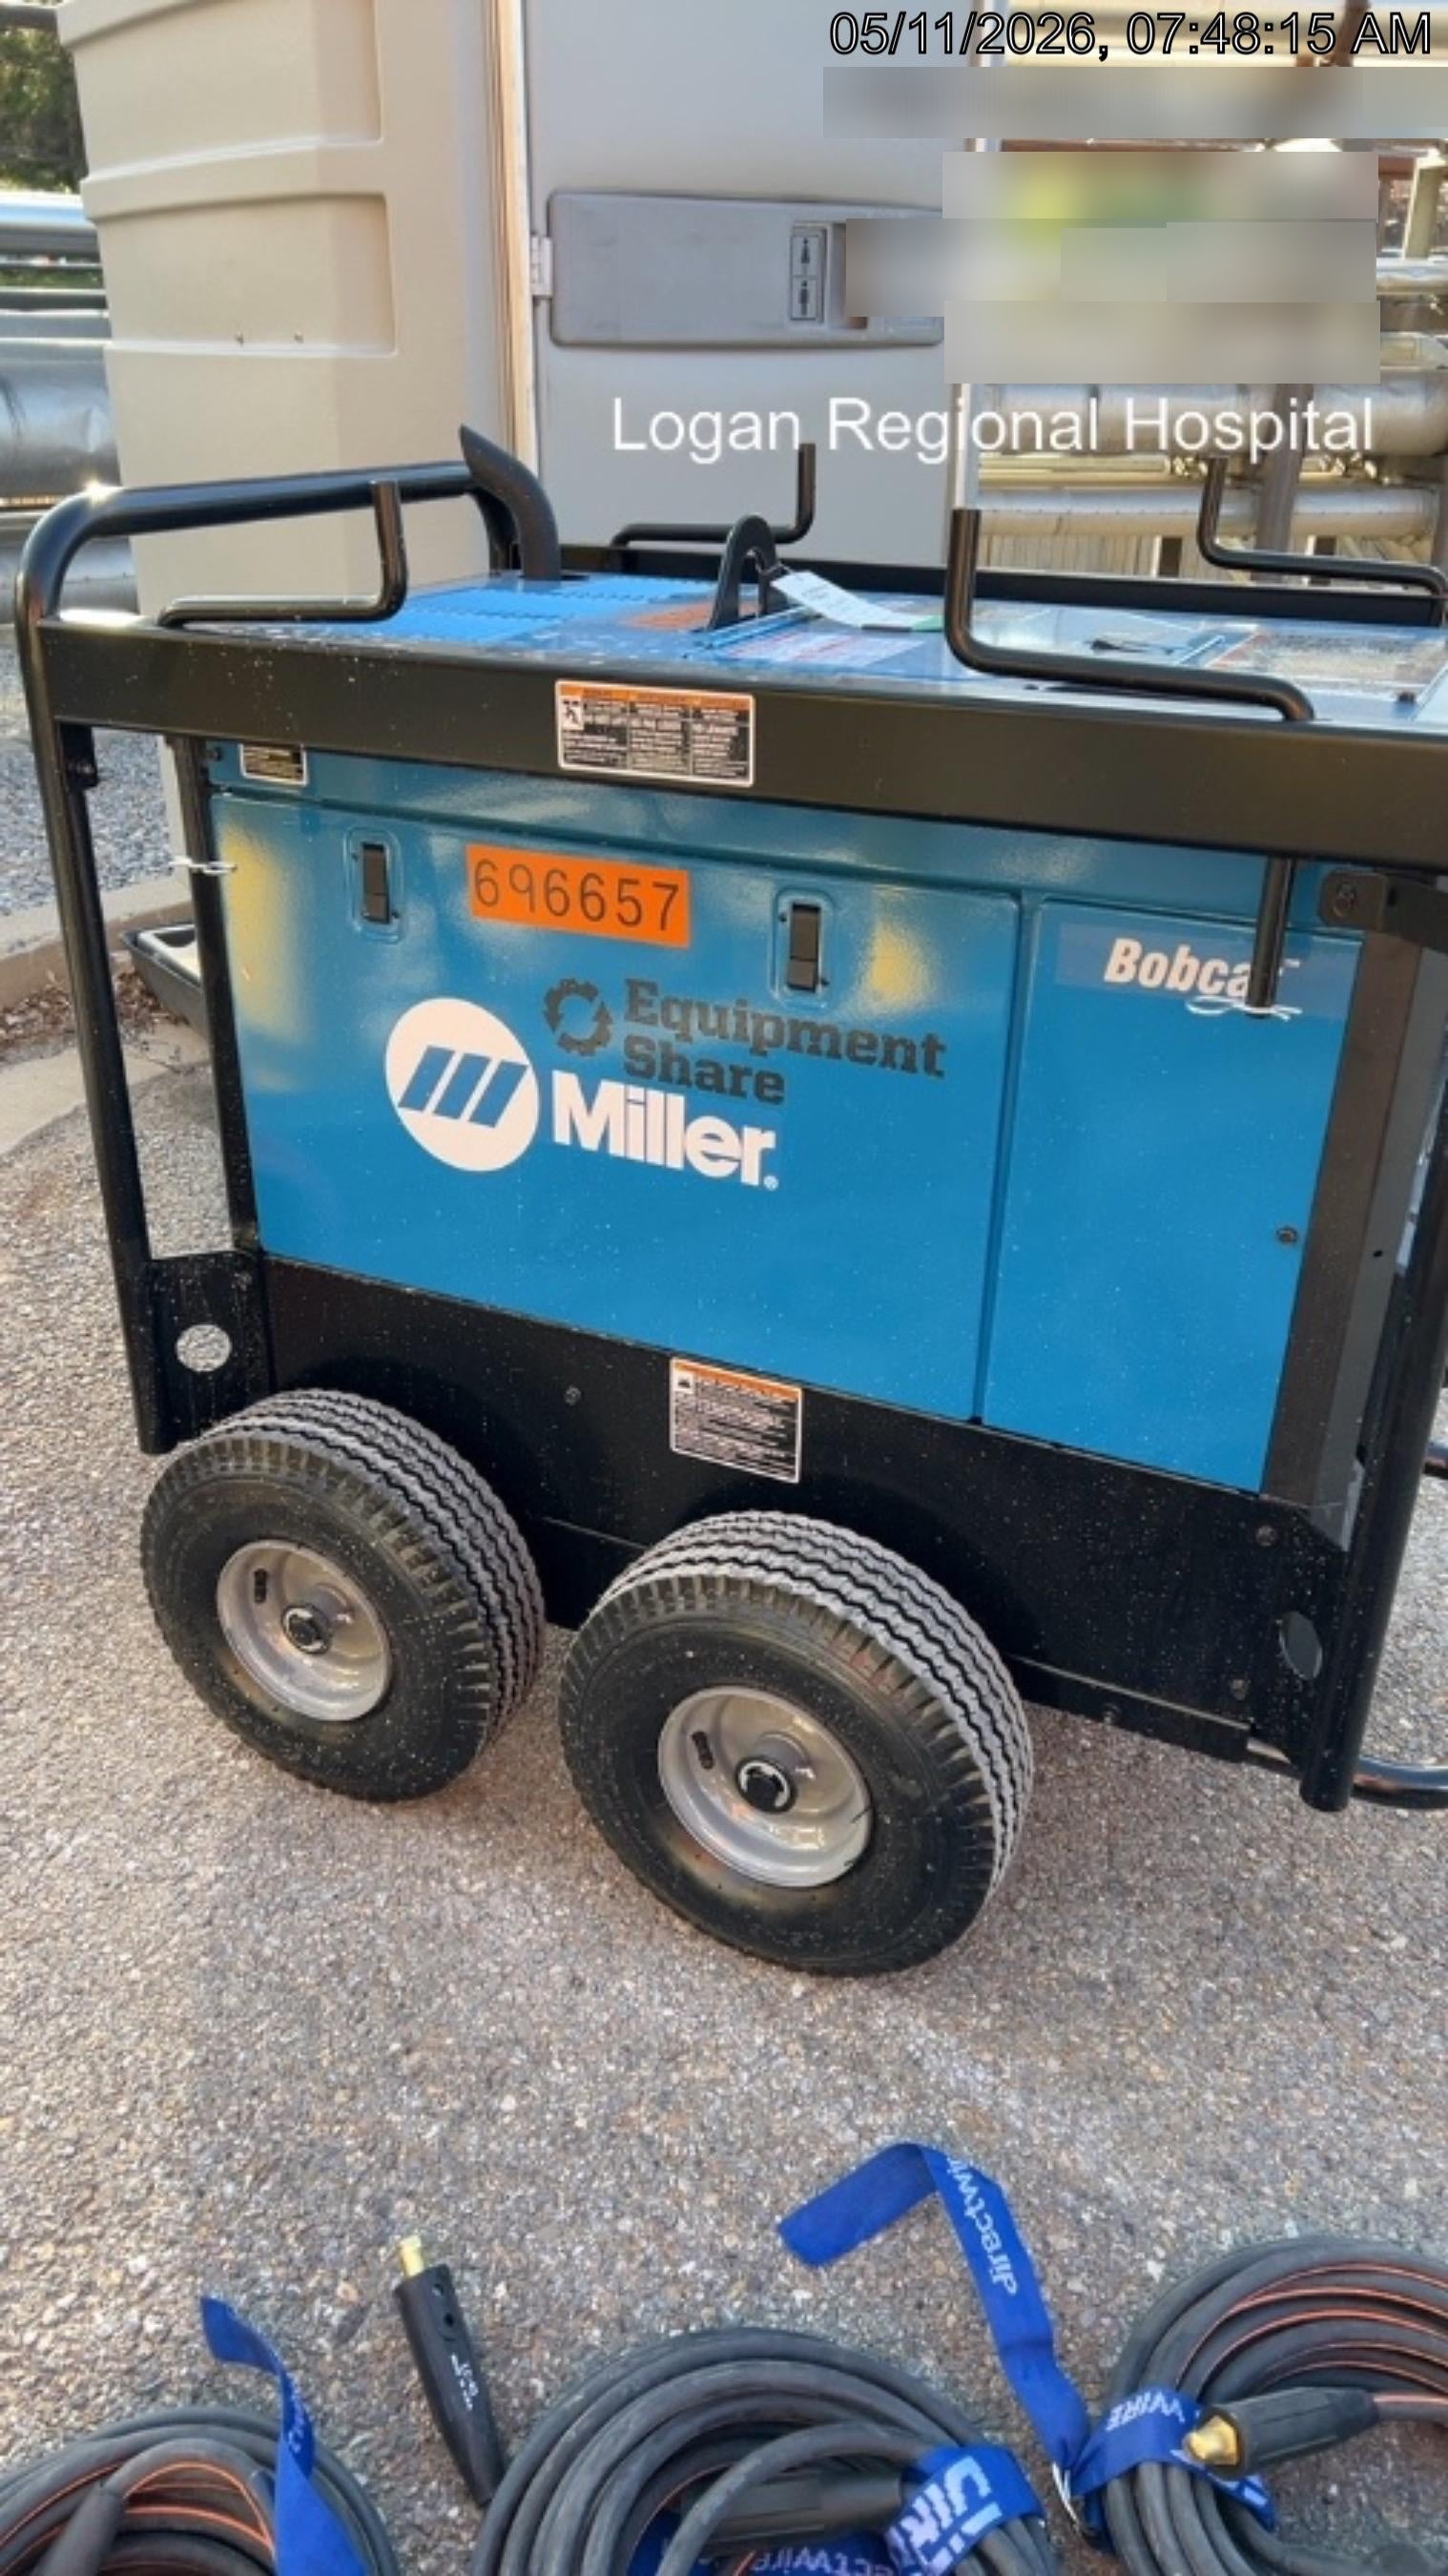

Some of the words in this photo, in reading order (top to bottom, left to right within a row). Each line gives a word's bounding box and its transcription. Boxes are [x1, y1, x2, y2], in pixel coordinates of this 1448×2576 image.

[473, 859, 680, 931] 696657
[1104, 937, 1278, 998] Bobca
[623, 978, 946, 1079] Equipment
[623, 1034, 785, 1105] Share
